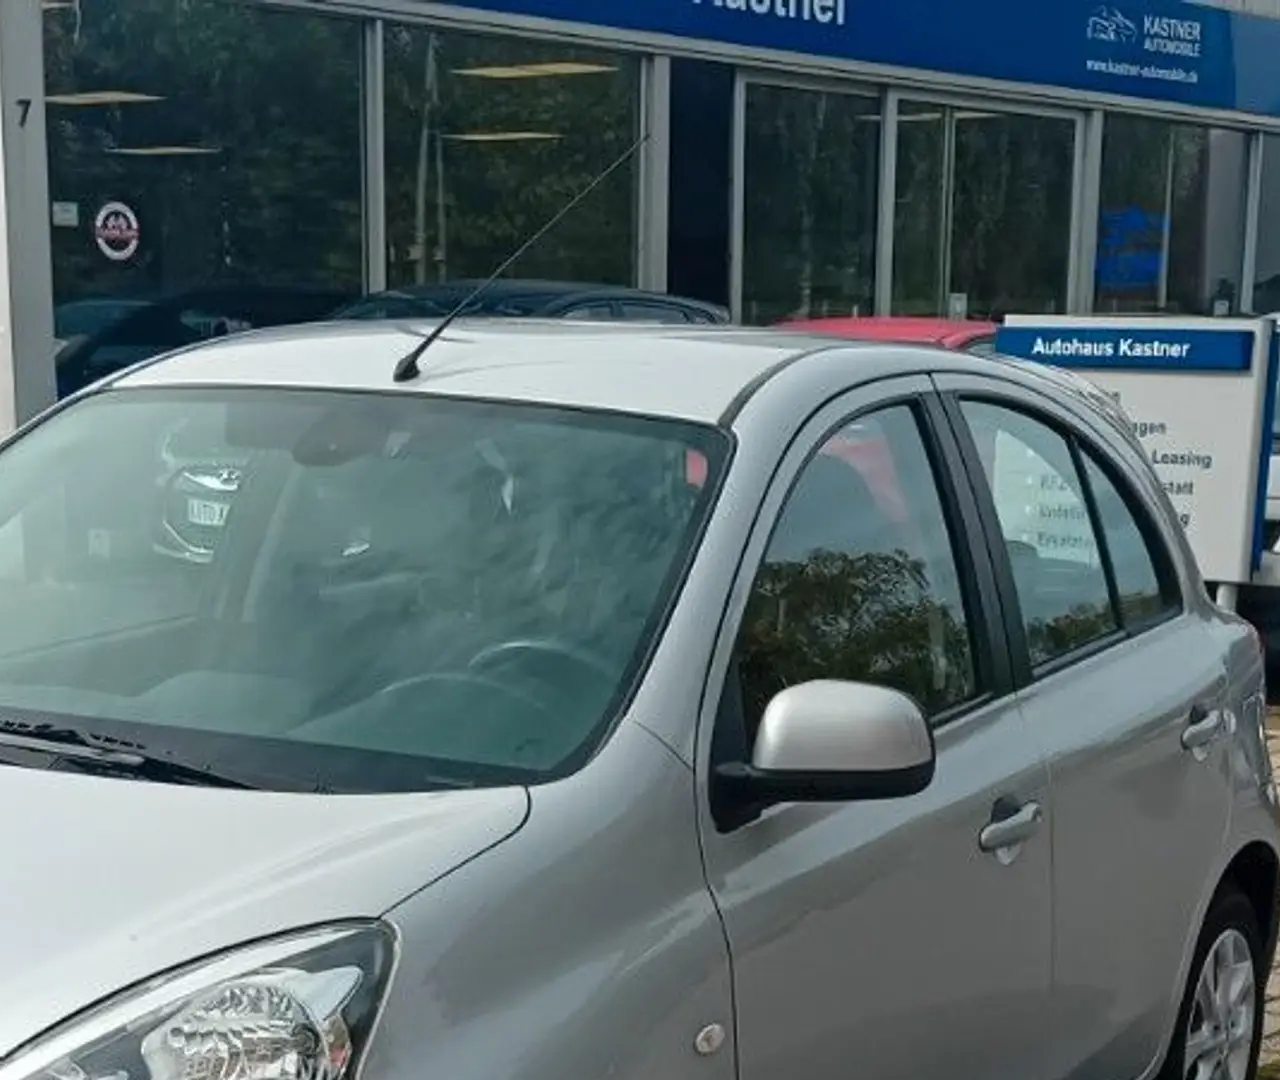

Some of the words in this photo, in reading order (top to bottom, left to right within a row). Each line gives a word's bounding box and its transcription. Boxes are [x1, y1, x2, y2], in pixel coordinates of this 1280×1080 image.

[1143, 15, 1201, 41] KASTNER
[14, 99, 32, 128] 7
[1031, 337, 1114, 357] Autohaus
[1119, 338, 1191, 358] Kastner
[1151, 448, 1213, 470] Leasing
